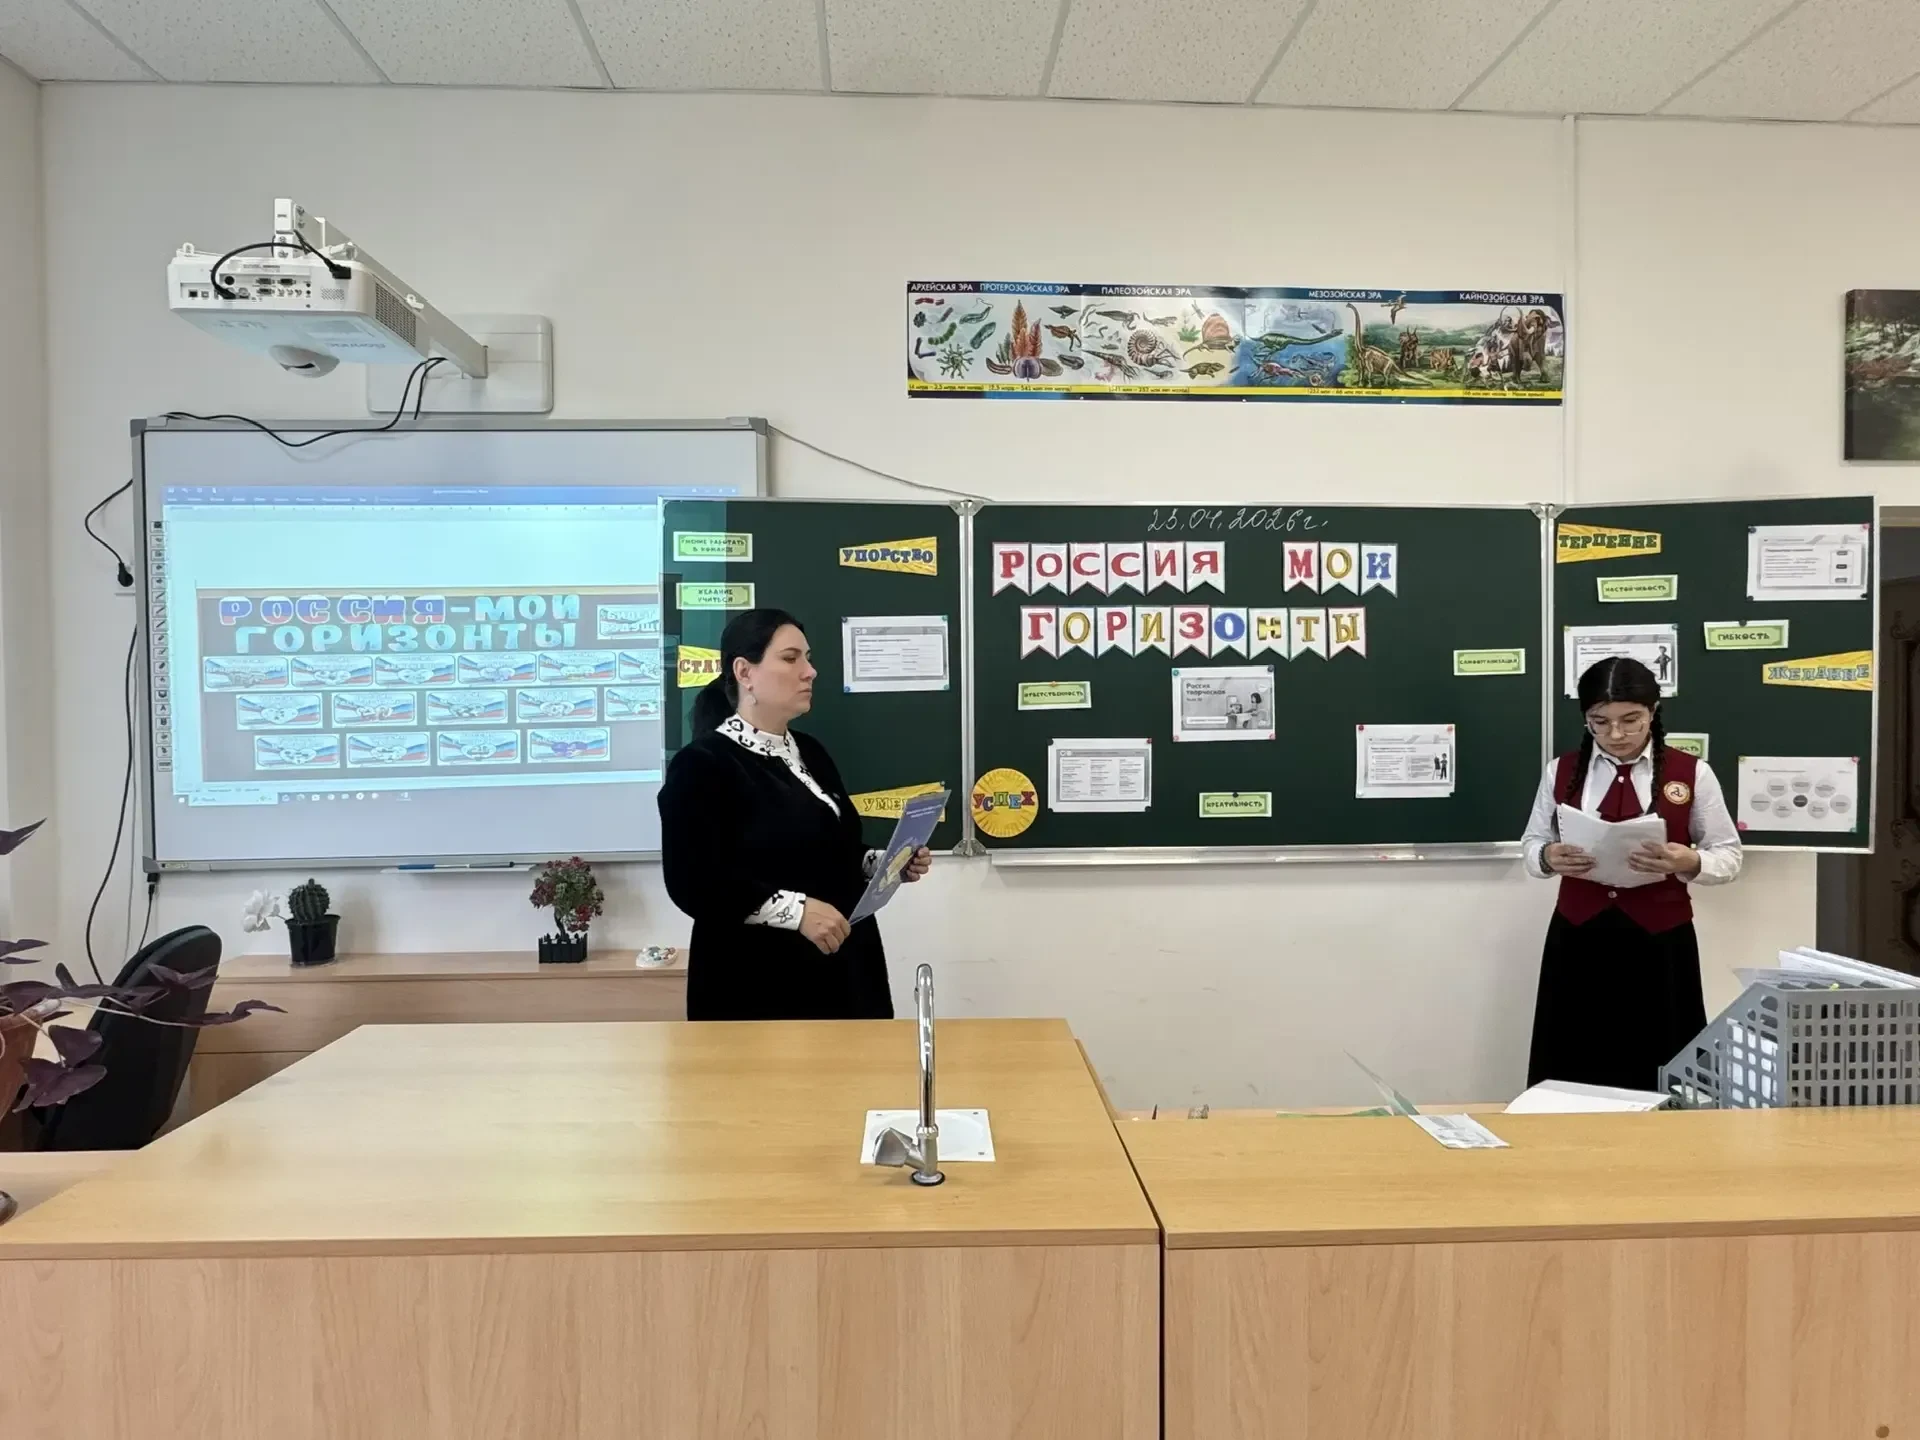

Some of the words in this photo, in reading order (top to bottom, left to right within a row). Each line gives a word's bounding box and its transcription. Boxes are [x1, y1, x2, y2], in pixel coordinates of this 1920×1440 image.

[910, 282, 956, 291] АРХЕЙСКАЯ
[958, 283, 974, 291] ЭРА
[979, 283, 1053, 293] ПРОТЕРОЗОЙСКАЯ
[1055, 285, 1071, 293] ЭРА
[1101, 286, 1172, 296] ПАЛЕОЗОЙСКАЯ
[1175, 288, 1192, 296] ЭРА
[1308, 290, 1366, 299] МЕЗОЗОЙСКАЯ
[1367, 291, 1382, 299] ЭРА
[1459, 292, 1528, 303] КАЙНОЗОЙСКАЯ
[1529, 295, 1545, 304] ЭРА
[1558, 533, 1658, 549] ТЕРПЕНИЕ
[842, 548, 934, 563] УПОРСТВО
[998, 549, 1219, 579] РОССИЯ
[1287, 547, 1393, 580] МОИ
[1605, 585, 1667, 593] НАСТОЙЧИВОСТЬ
[1026, 610, 1360, 645] ГОРИЗОНТЫ
[235, 622, 577, 654] ГОРИЗОНТЫ
[1717, 632, 1770, 641] ГИБКОСТЬ
[1767, 663, 1870, 681] ЖЕЛАНИЕ
[1024, 690, 1084, 698] ОТВЕТСТВЕННОСТЬ
[862, 797, 907, 812] УМЕ
[972, 790, 1036, 812] УСПЕХ
